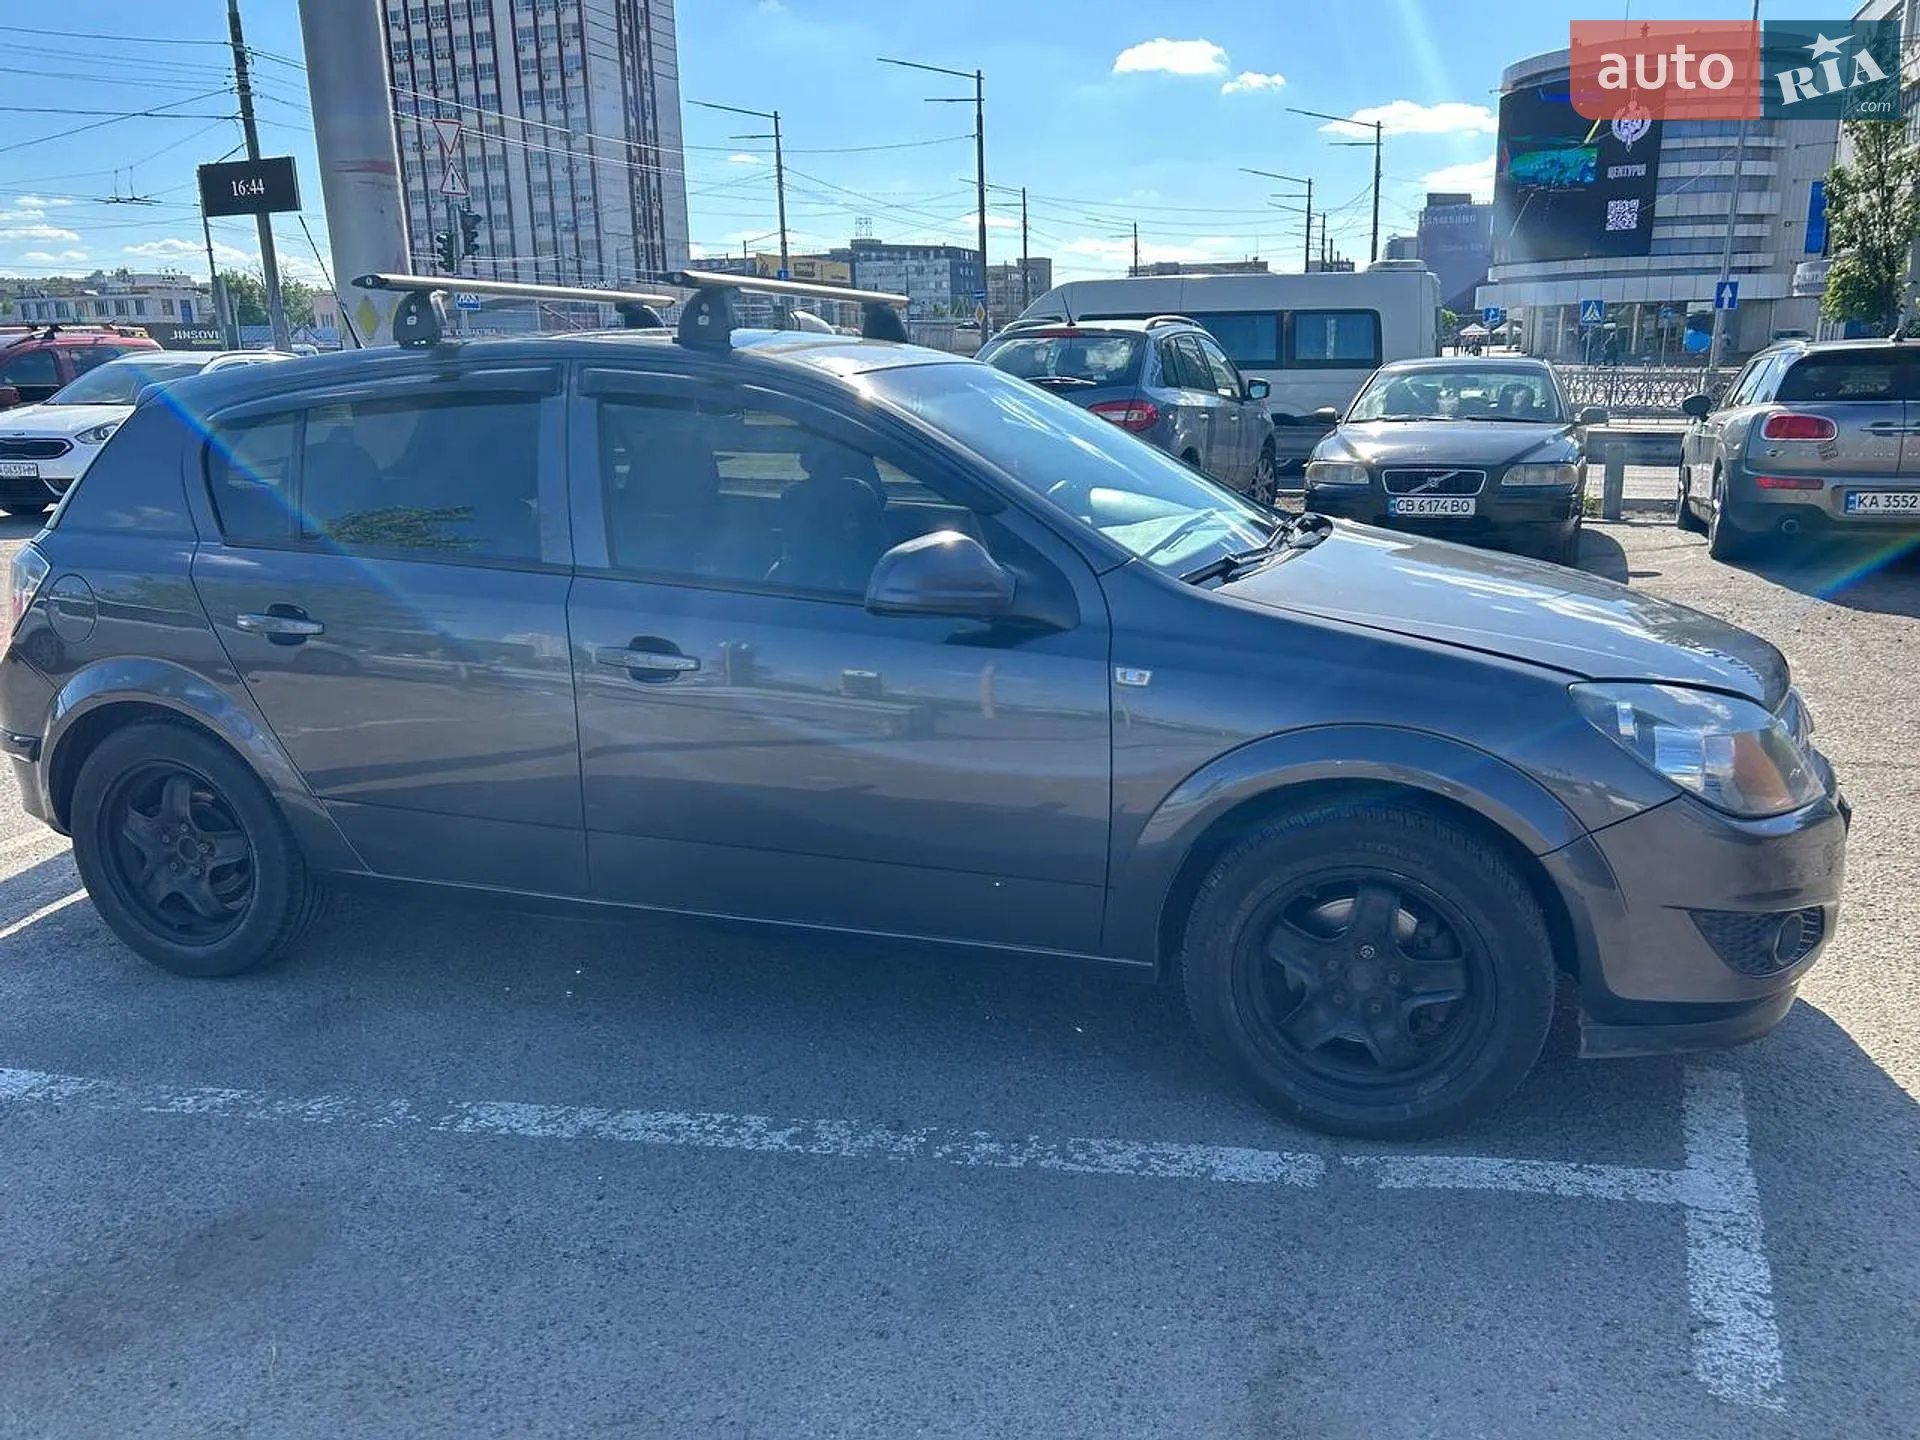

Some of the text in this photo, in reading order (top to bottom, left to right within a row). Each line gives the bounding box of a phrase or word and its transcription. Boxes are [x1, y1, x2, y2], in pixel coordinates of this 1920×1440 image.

[231, 178, 265, 196] 16:44
[1396, 499, 1415, 512] CB
[1418, 499, 1449, 512] 6174
[1857, 495, 1918, 509] KA 3552
